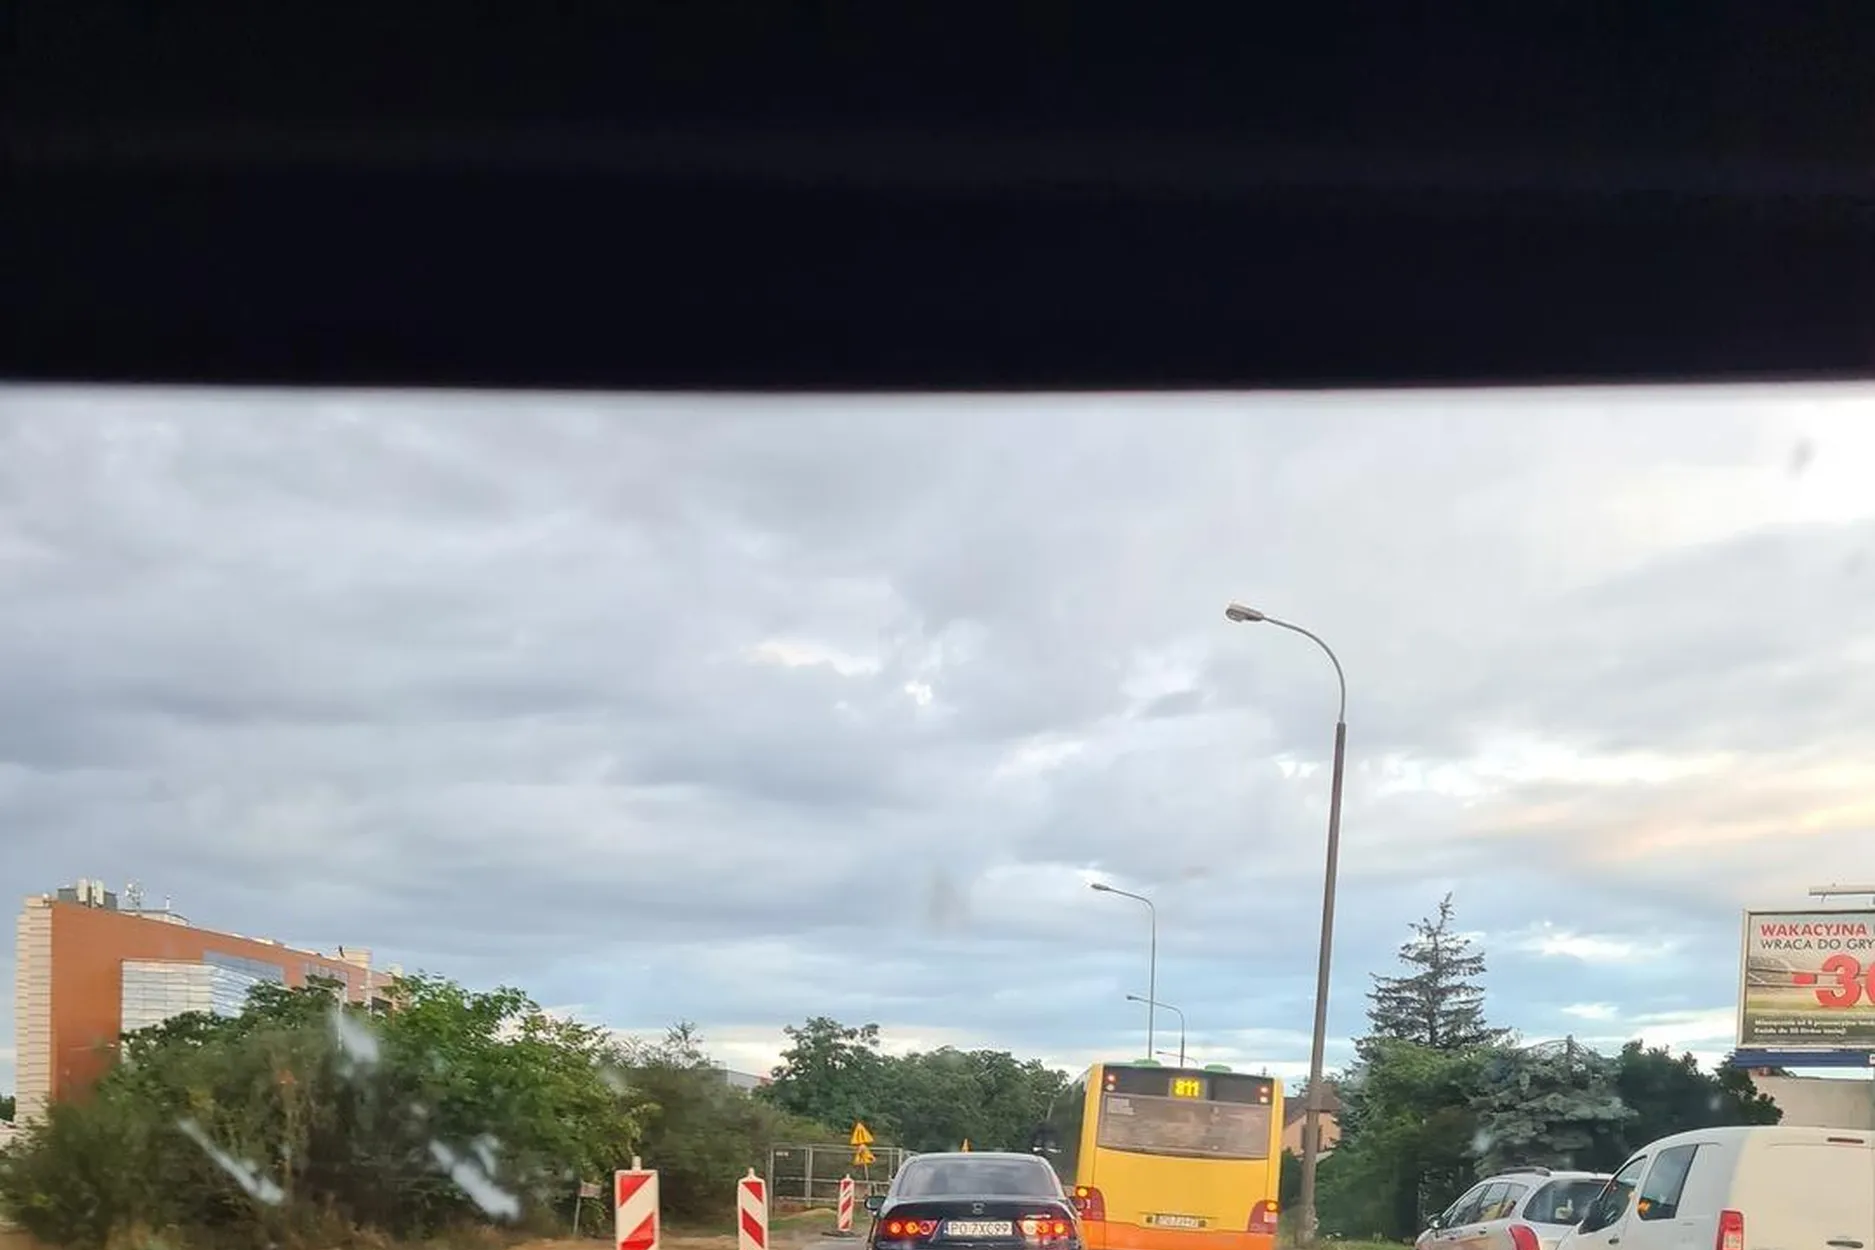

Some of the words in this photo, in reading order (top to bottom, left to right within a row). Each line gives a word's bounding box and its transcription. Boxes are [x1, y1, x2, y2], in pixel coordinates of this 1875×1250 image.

[1760, 923, 1867, 937] WAKACYJNA
[1760, 938, 1813, 950] WRACA
[1817, 938, 1841, 950] DO
[1175, 1078, 1200, 1097] 811
